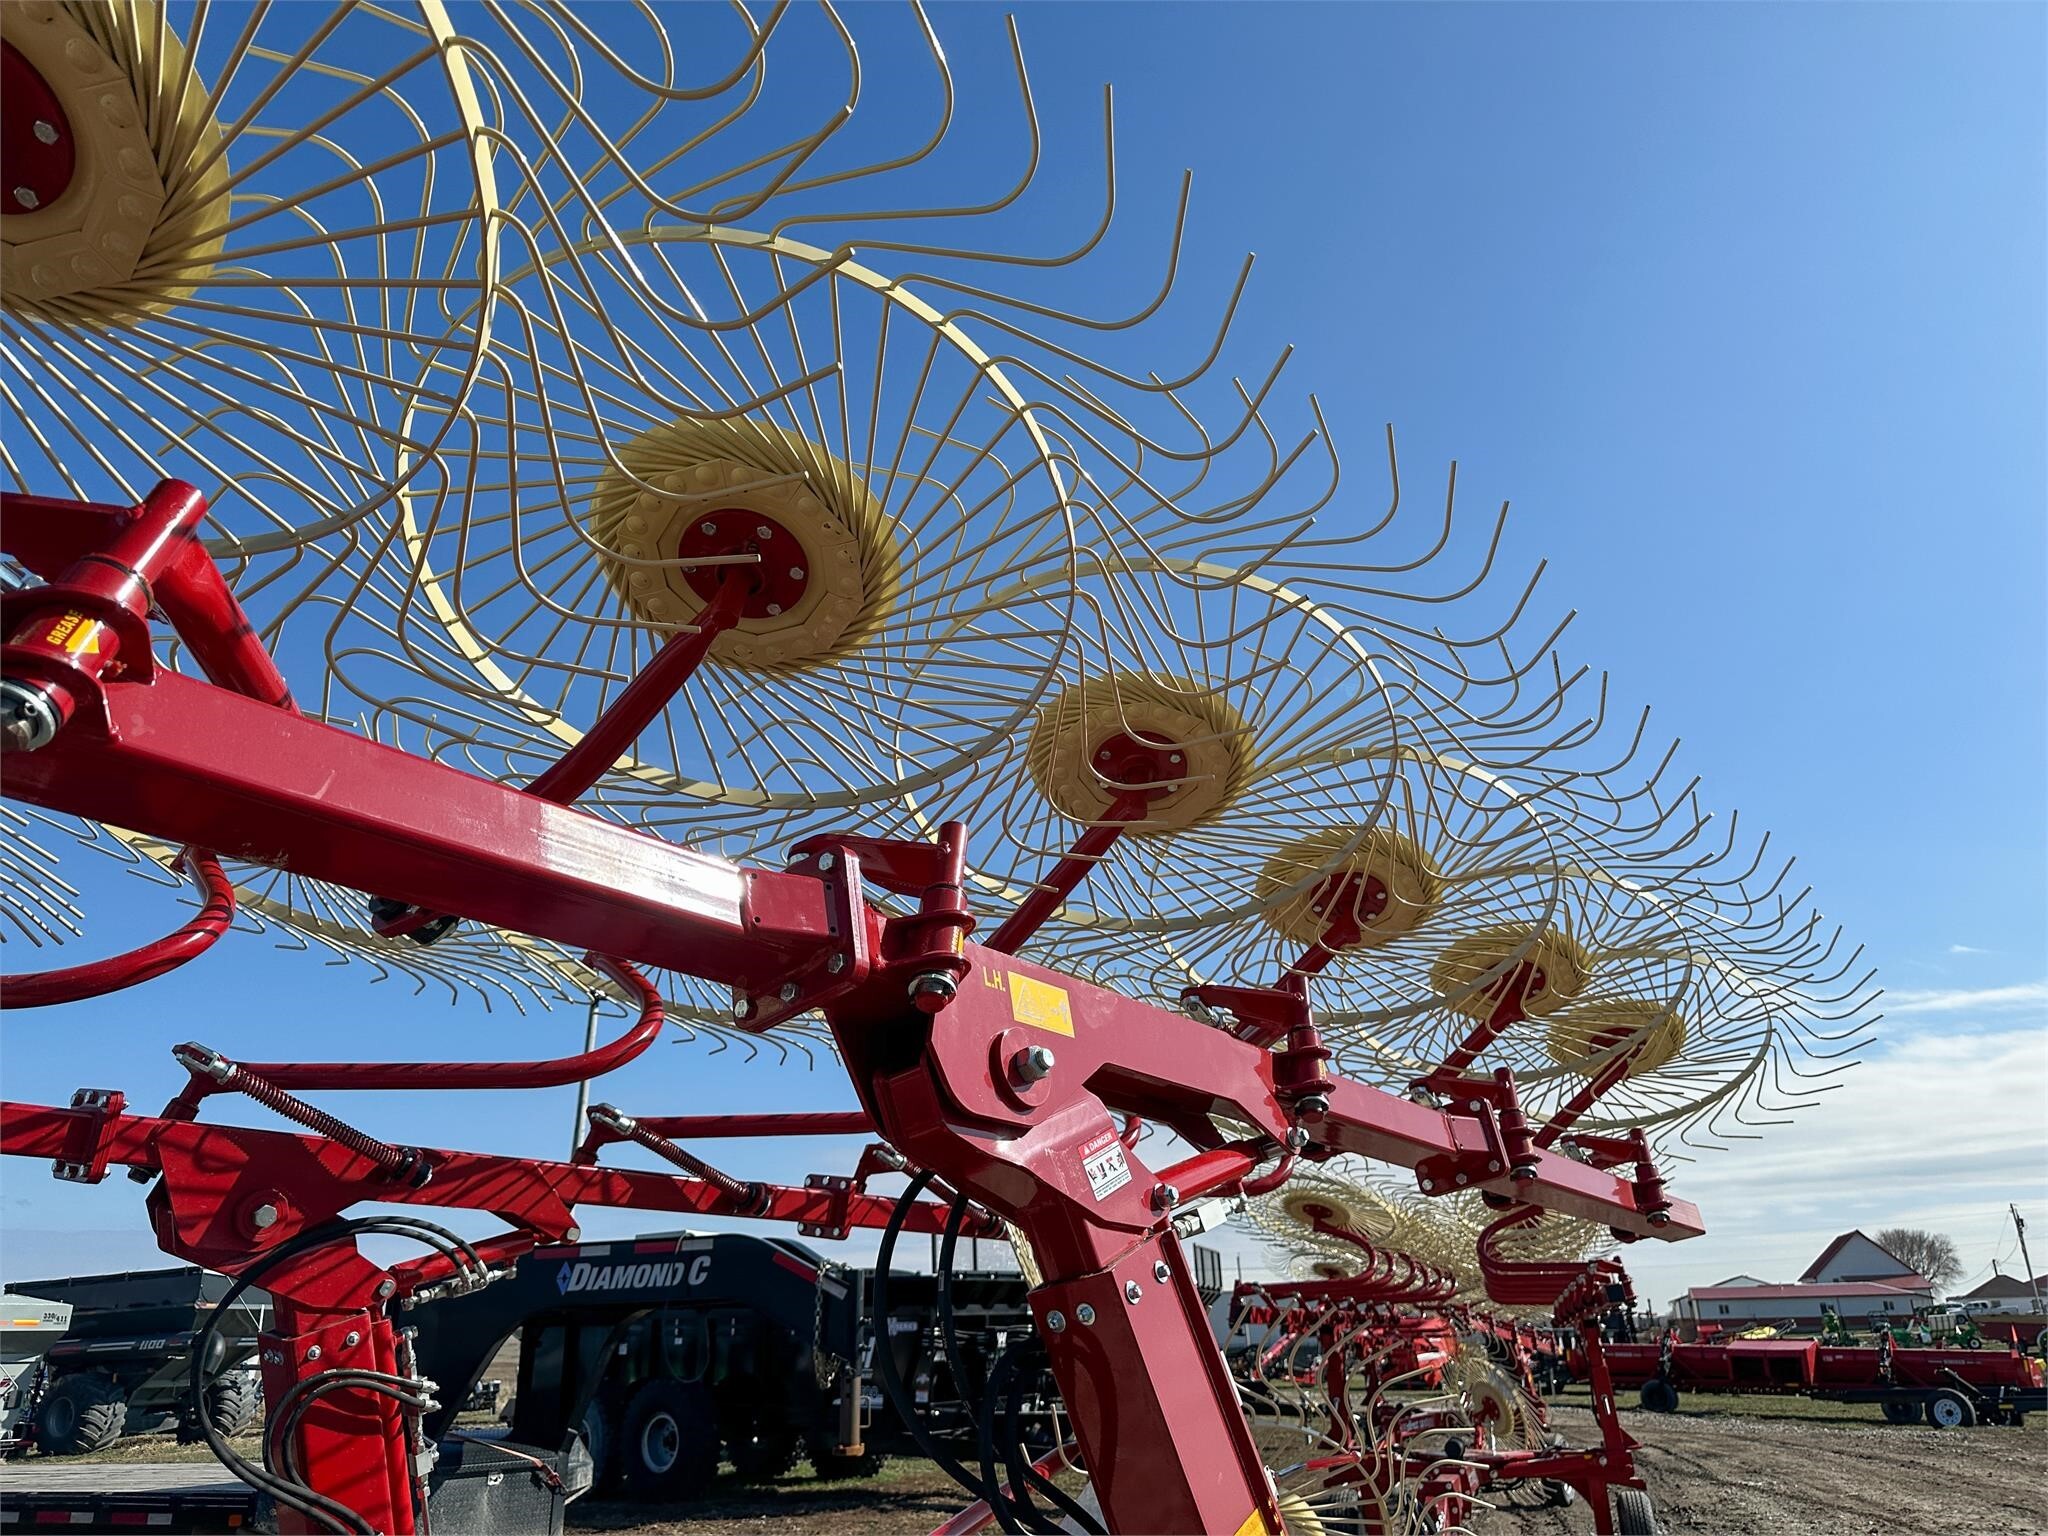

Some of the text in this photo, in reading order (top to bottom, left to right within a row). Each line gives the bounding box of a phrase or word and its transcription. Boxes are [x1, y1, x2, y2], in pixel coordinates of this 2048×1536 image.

[47, 609, 84, 646] GREASE
[982, 966, 1006, 993] L.H.
[1088, 1132, 1113, 1151] DANGER
[688, 1255, 711, 1286] C
[138, 1338, 166, 1350] 1100
